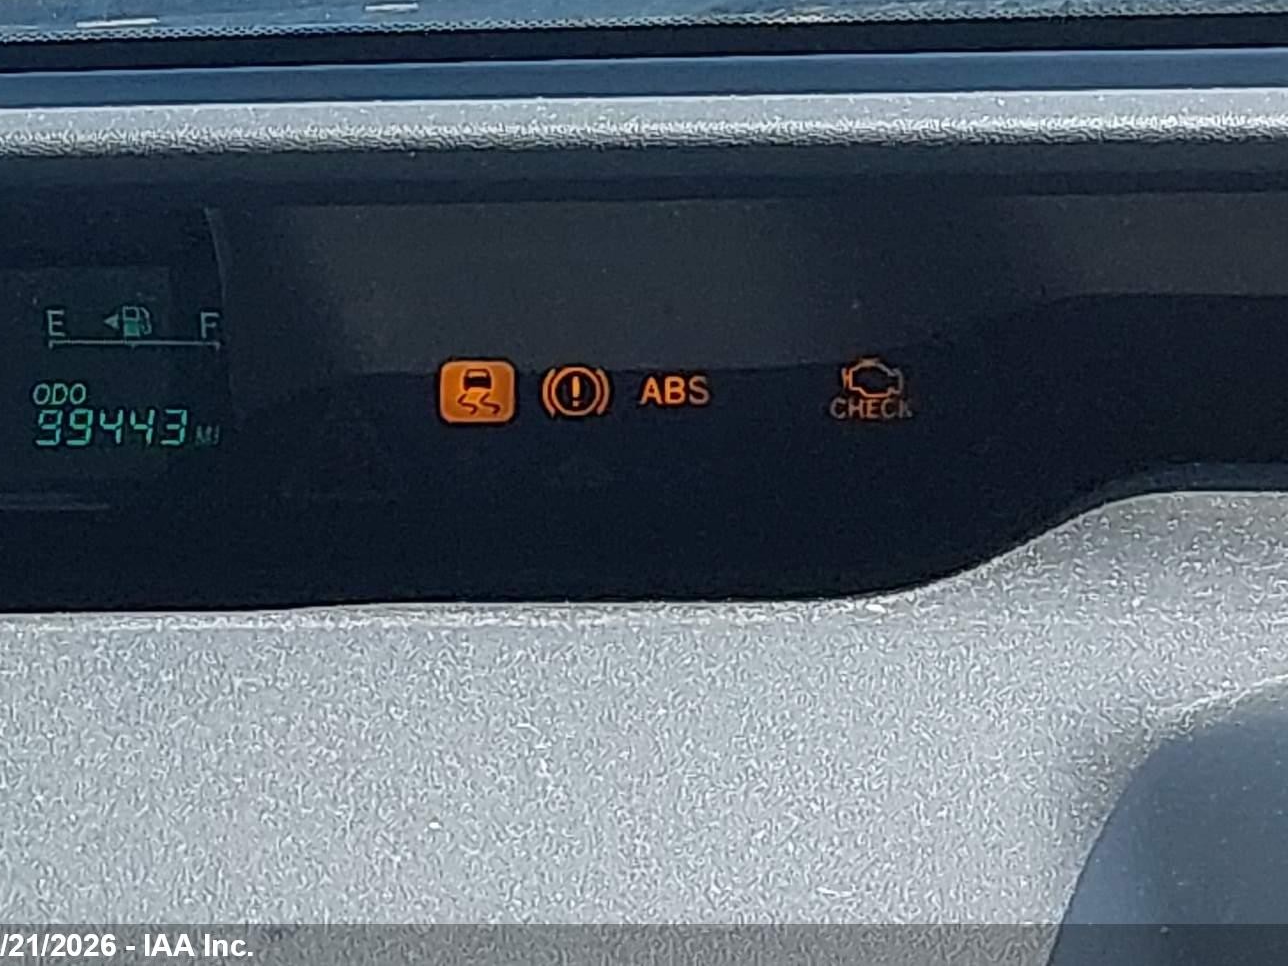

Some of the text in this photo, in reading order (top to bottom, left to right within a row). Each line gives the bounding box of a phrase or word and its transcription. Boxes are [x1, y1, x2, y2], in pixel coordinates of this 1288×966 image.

[47, 310, 64, 336] E
[200, 312, 219, 338] F
[33, 383, 87, 405] ODO
[639, 375, 710, 407] ABS
[829, 396, 912, 419] CHECK
[36, 409, 188, 446] 99443
